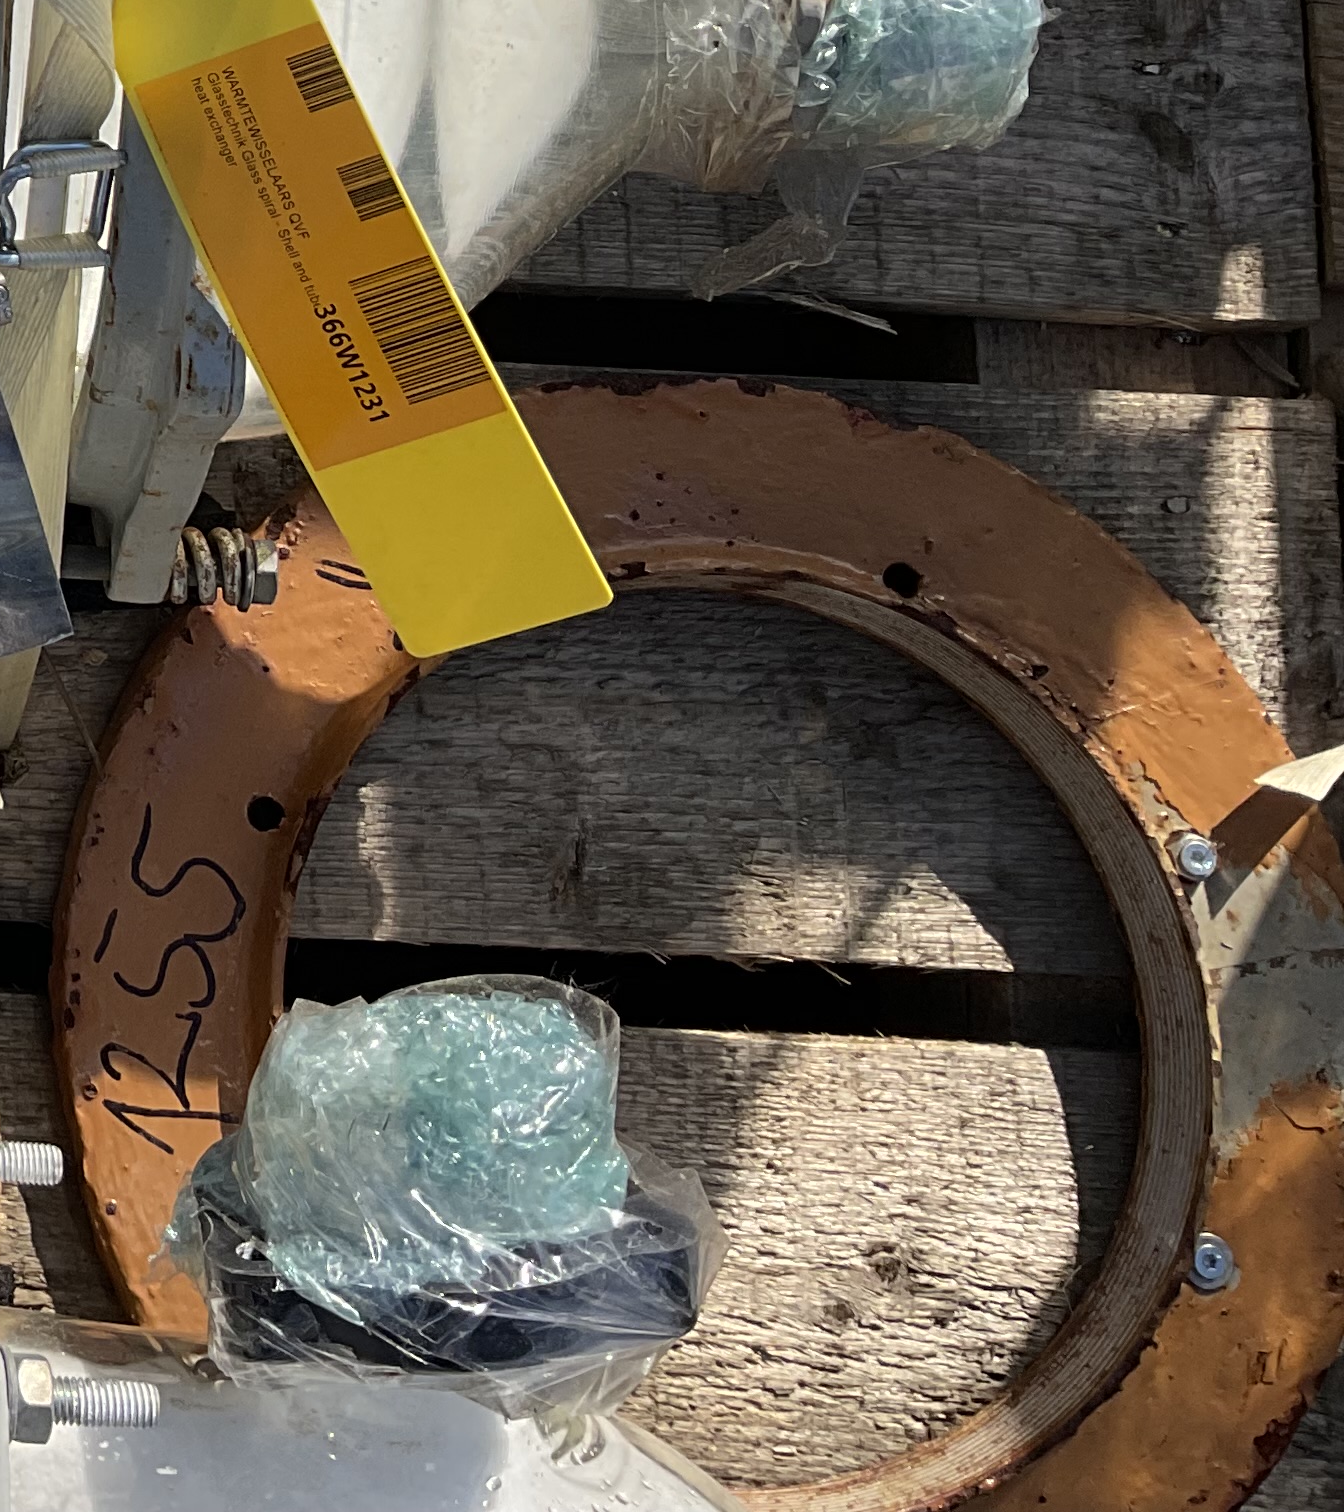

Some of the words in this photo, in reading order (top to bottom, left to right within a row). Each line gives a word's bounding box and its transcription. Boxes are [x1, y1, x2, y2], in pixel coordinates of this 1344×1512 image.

[191, 77, 210, 105] heat
[204, 107, 238, 167] exchanger
[207, 72, 247, 148] Glasstechnik
[242, 150, 262, 184] Glass
[258, 187, 282, 219] spiral
[278, 228, 300, 259] Shell
[293, 261, 310, 283] and
[221, 65, 295, 210] WARMTEWISSELAARS
[289, 213, 310, 239] QVF
[314, 303, 390, 422] 366W1231
